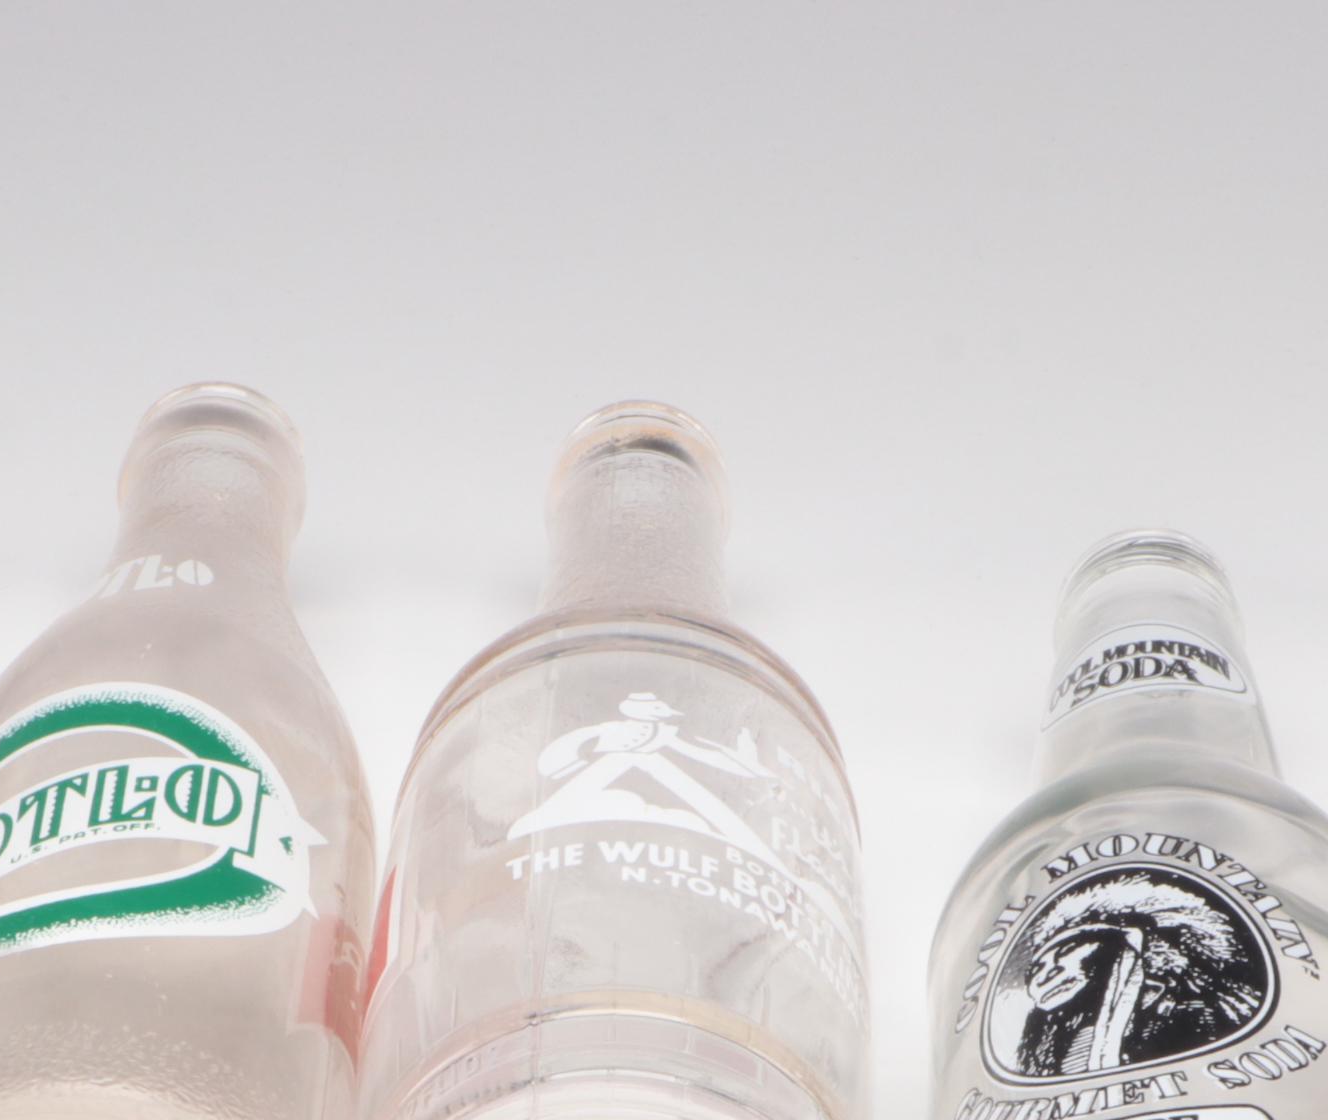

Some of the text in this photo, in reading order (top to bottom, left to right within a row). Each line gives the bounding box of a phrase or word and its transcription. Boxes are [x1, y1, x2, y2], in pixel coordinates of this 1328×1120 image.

[1070, 655, 1205, 708] SODA
[1102, 639, 1231, 680] MOUNTAIN
[59, 828, 107, 843] PAT.
[113, 821, 161, 832] OFF.
[505, 843, 584, 880] THE
[598, 841, 719, 878] WULF
[1041, 833, 1319, 970] MOUNTAIN
[1204, 1025, 1326, 1090] SODA
